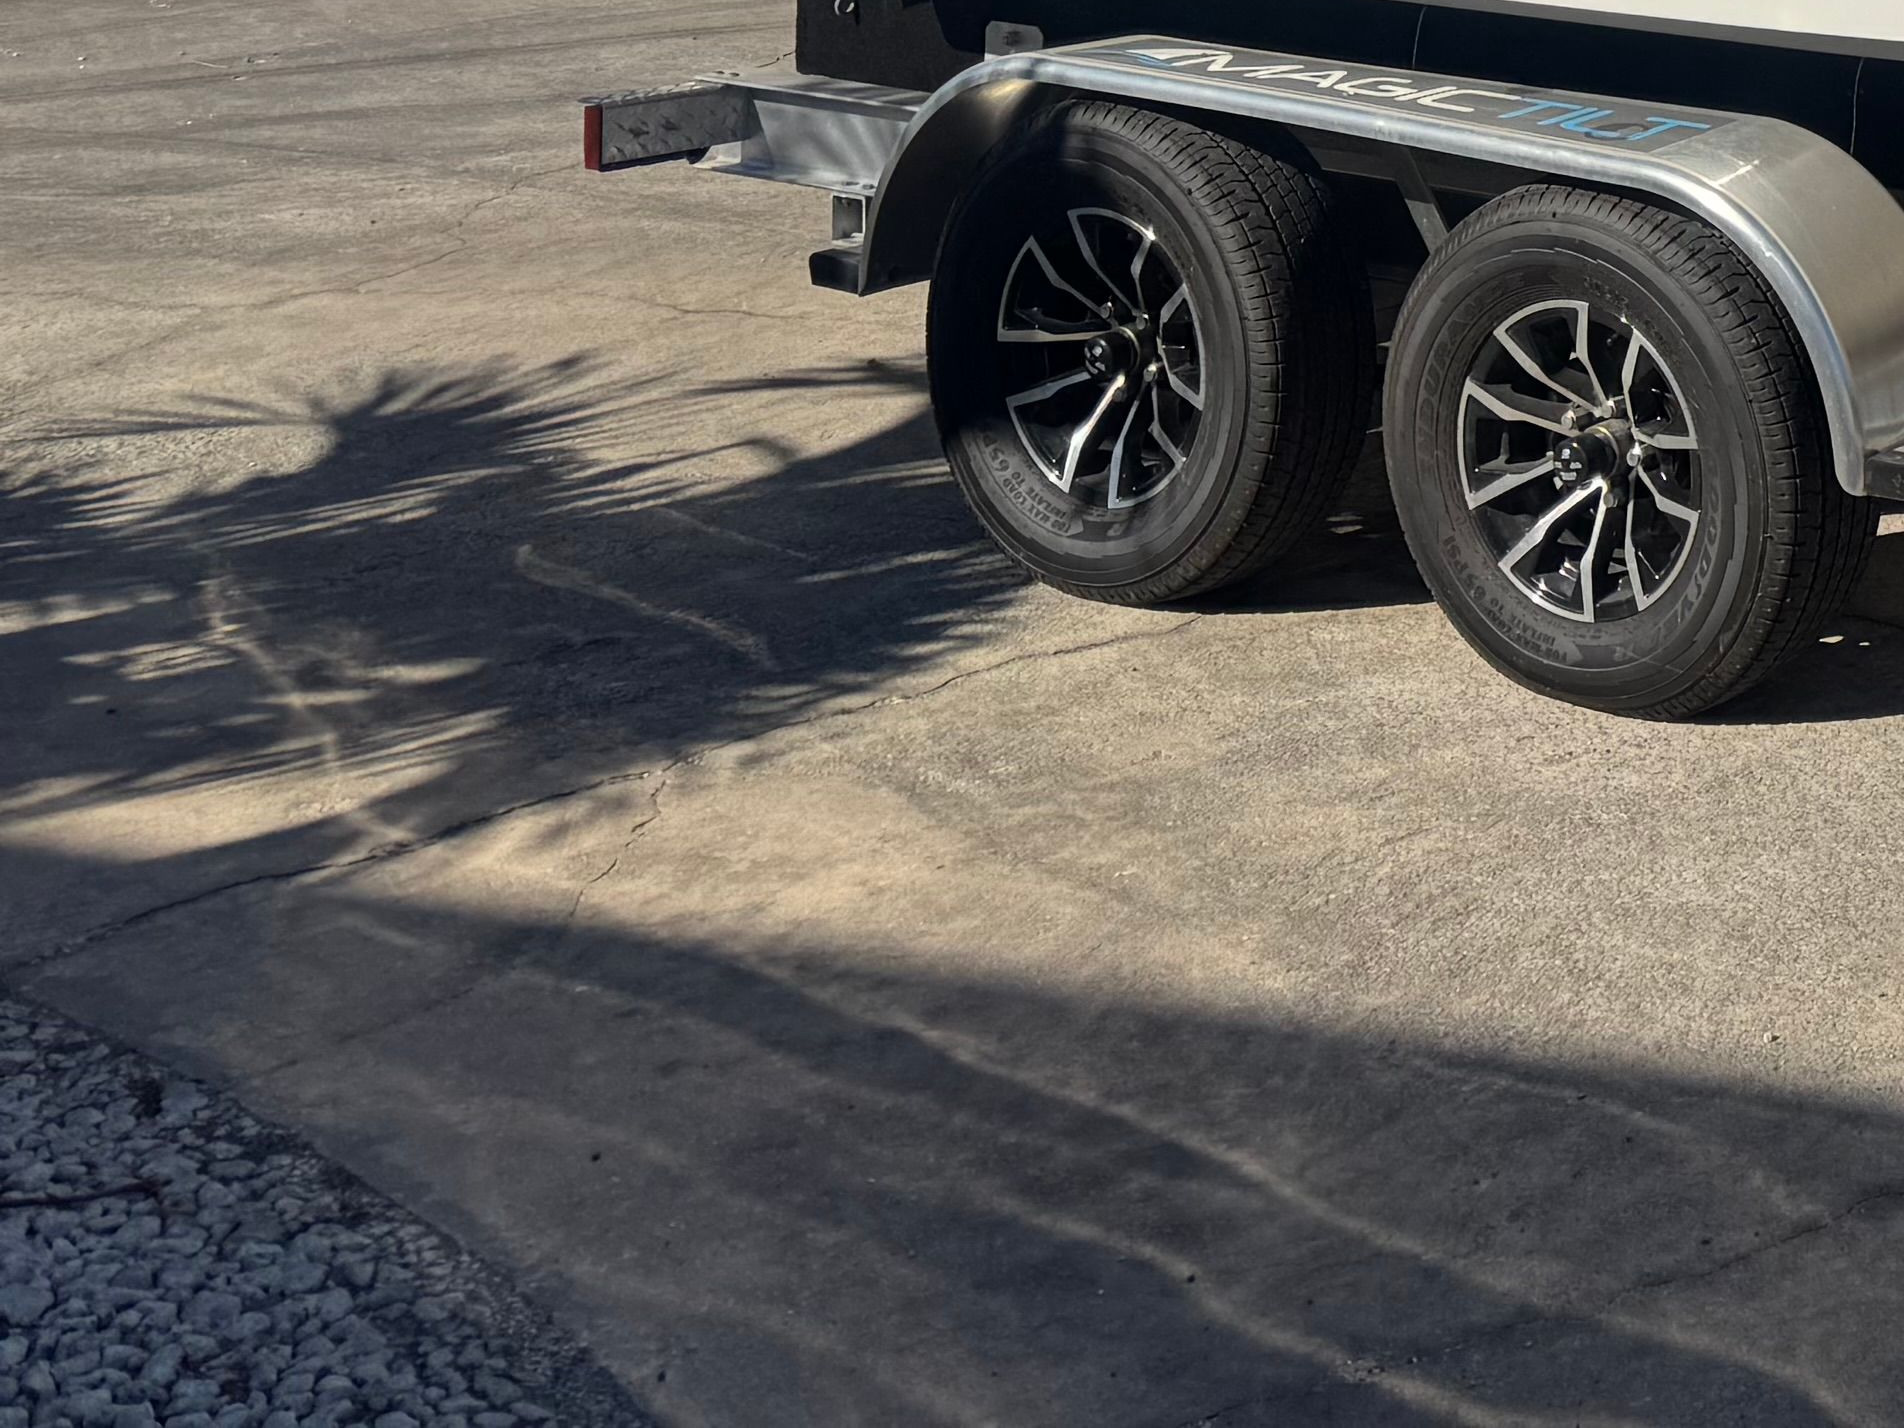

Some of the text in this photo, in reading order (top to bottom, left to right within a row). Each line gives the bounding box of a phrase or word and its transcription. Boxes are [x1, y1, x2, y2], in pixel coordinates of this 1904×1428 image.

[1172, 49, 1712, 142] MAGICTILT
[1002, 477, 1027, 506] LOAD
[1011, 471, 1026, 488] TO
